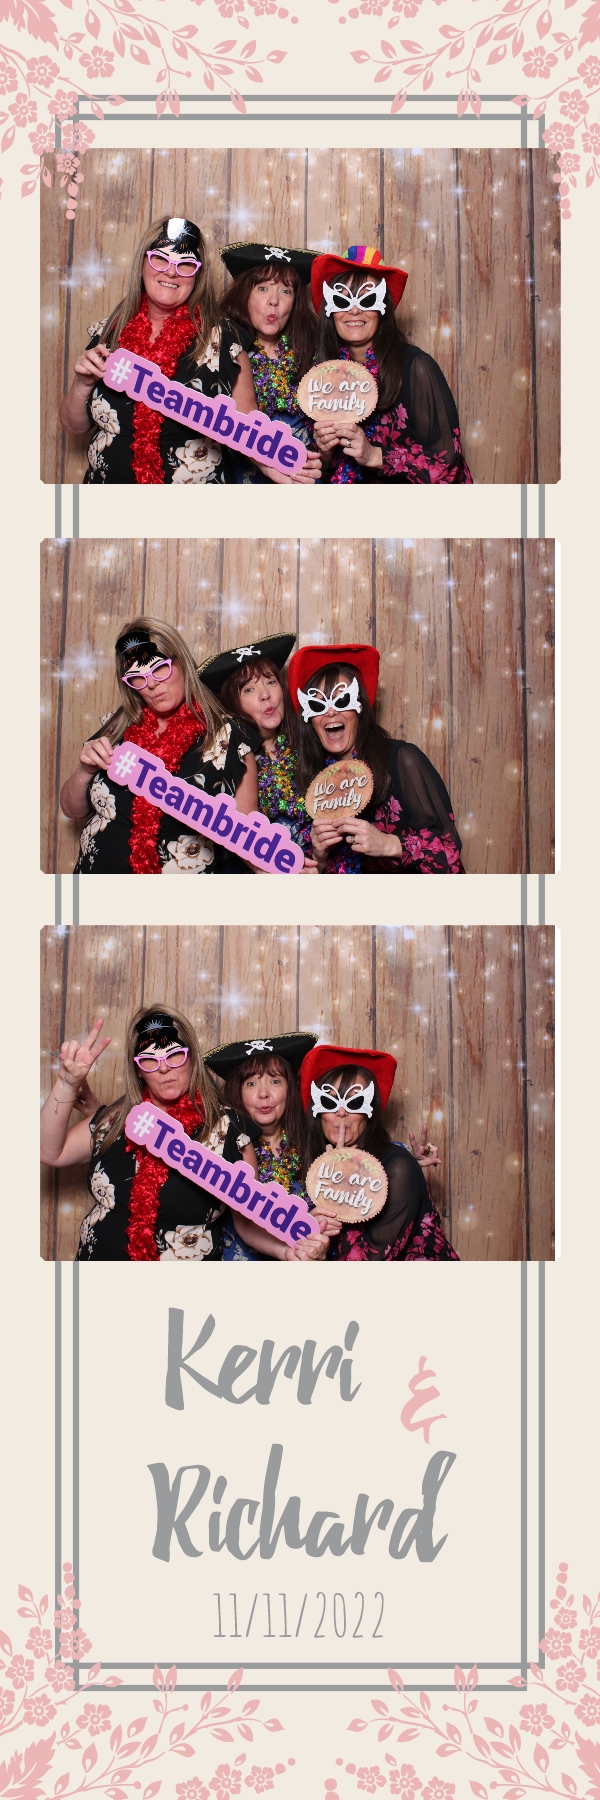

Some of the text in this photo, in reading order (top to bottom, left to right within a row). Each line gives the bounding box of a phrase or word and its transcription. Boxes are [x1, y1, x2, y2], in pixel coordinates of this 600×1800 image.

[307, 376, 372, 394] We are
[110, 357, 299, 468] #Teambride
[308, 392, 367, 416] Family
[313, 775, 369, 797] We are
[313, 788, 363, 814] Family
[115, 750, 296, 873] #Teambride
[132, 1110, 312, 1242] #Teambride
[317, 1161, 383, 1192] We are
[314, 1181, 374, 1216] Family
